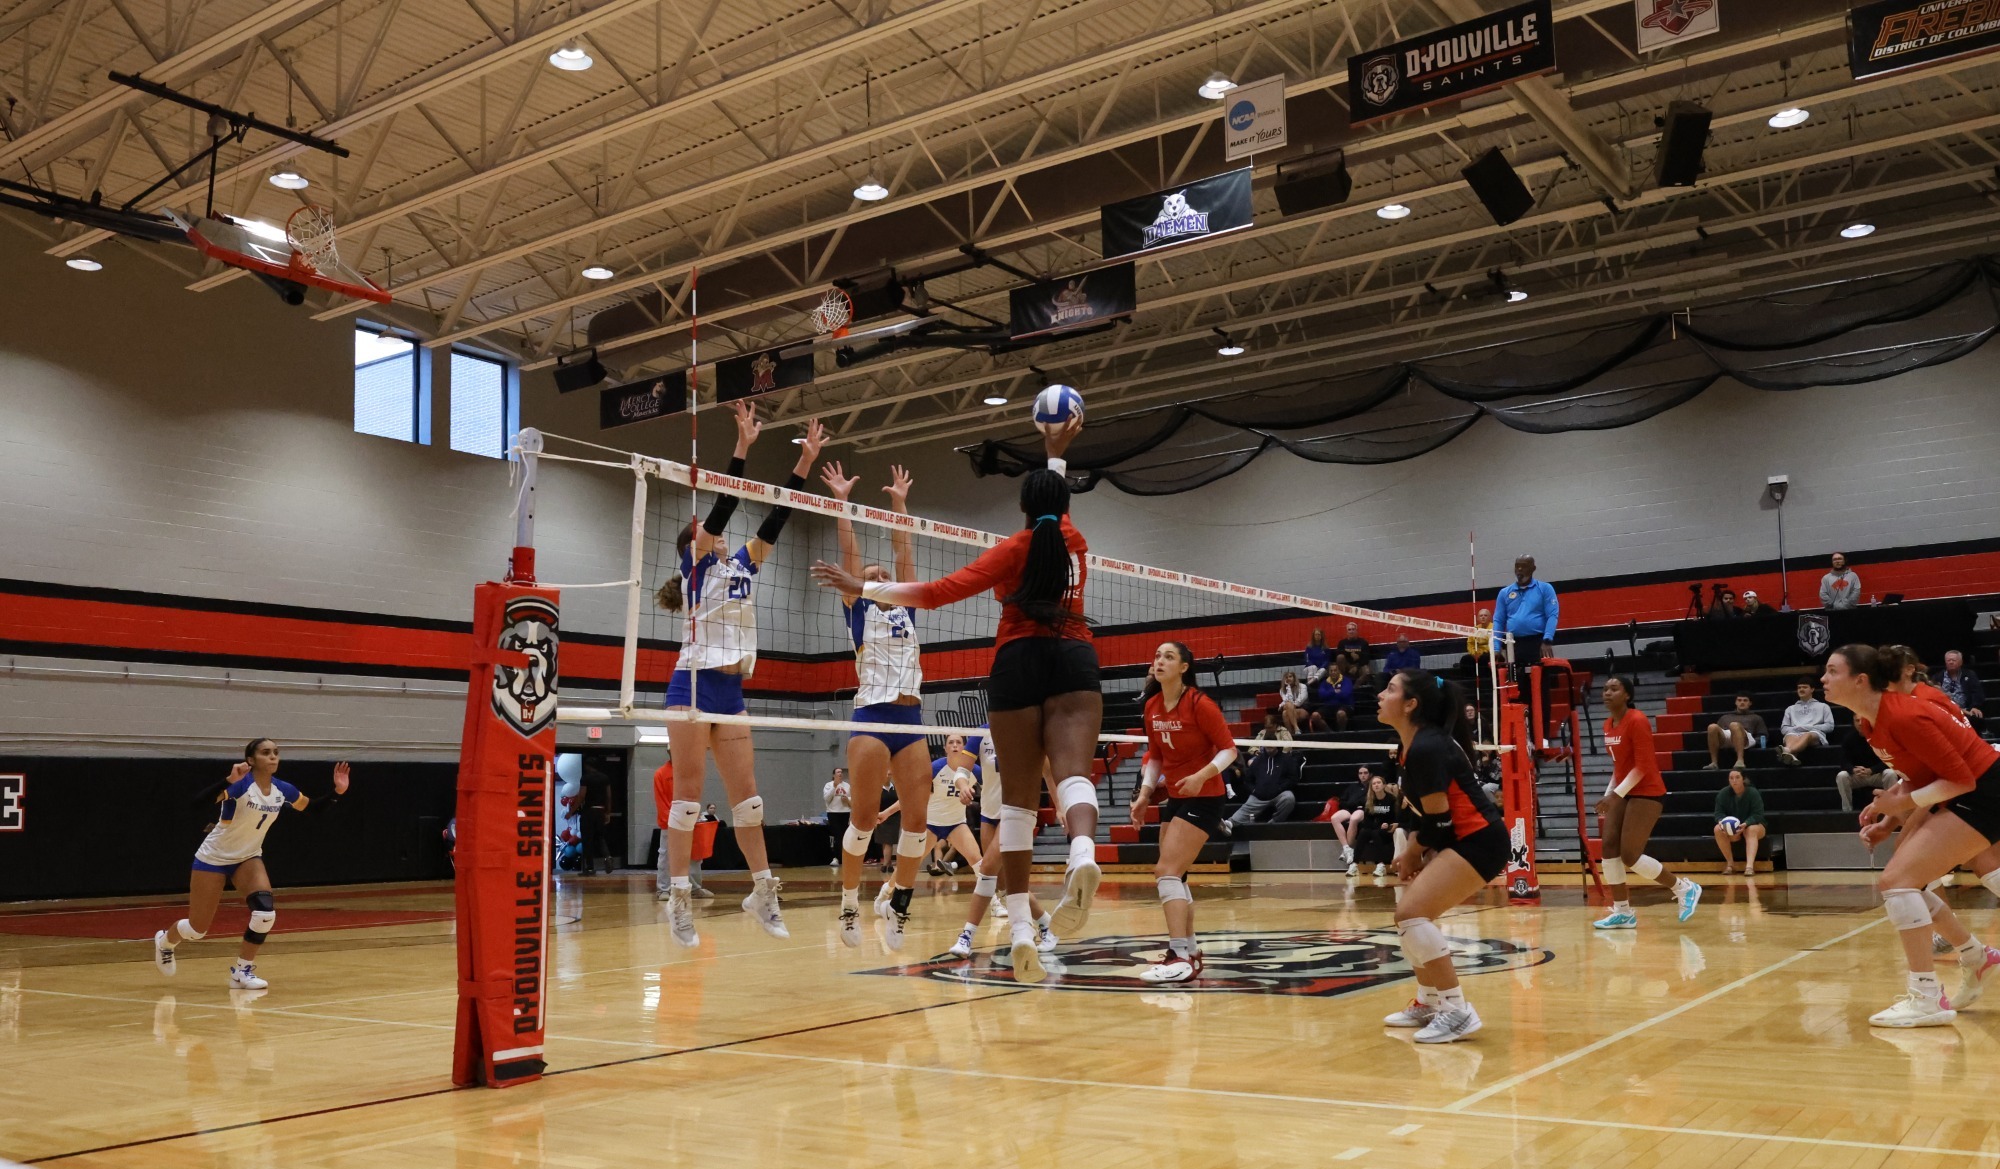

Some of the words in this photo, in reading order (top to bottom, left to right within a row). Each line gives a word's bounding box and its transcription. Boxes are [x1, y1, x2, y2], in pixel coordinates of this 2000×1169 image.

[1876, 0, 2000, 47] FIREBI
[1874, 38, 1927, 57] DISTRICT
[1929, 33, 1945, 43] OF
[1423, 55, 1522, 90] SAINTS
[1232, 111, 1256, 126] NCAA
[1230, 138, 1248, 148] MAKE
[1145, 213, 1207, 245] DAEMEN
[1051, 306, 1093, 324] KNIGHTS
[620, 393, 651, 411] MERCY
[622, 399, 660, 417] COLLEGE
[729, 577, 750, 599] 20
[522, 709, 533, 719] DY
[1161, 732, 1175, 750] 4
[0, 774, 24, 831] E
[256, 814, 268, 830] 1
